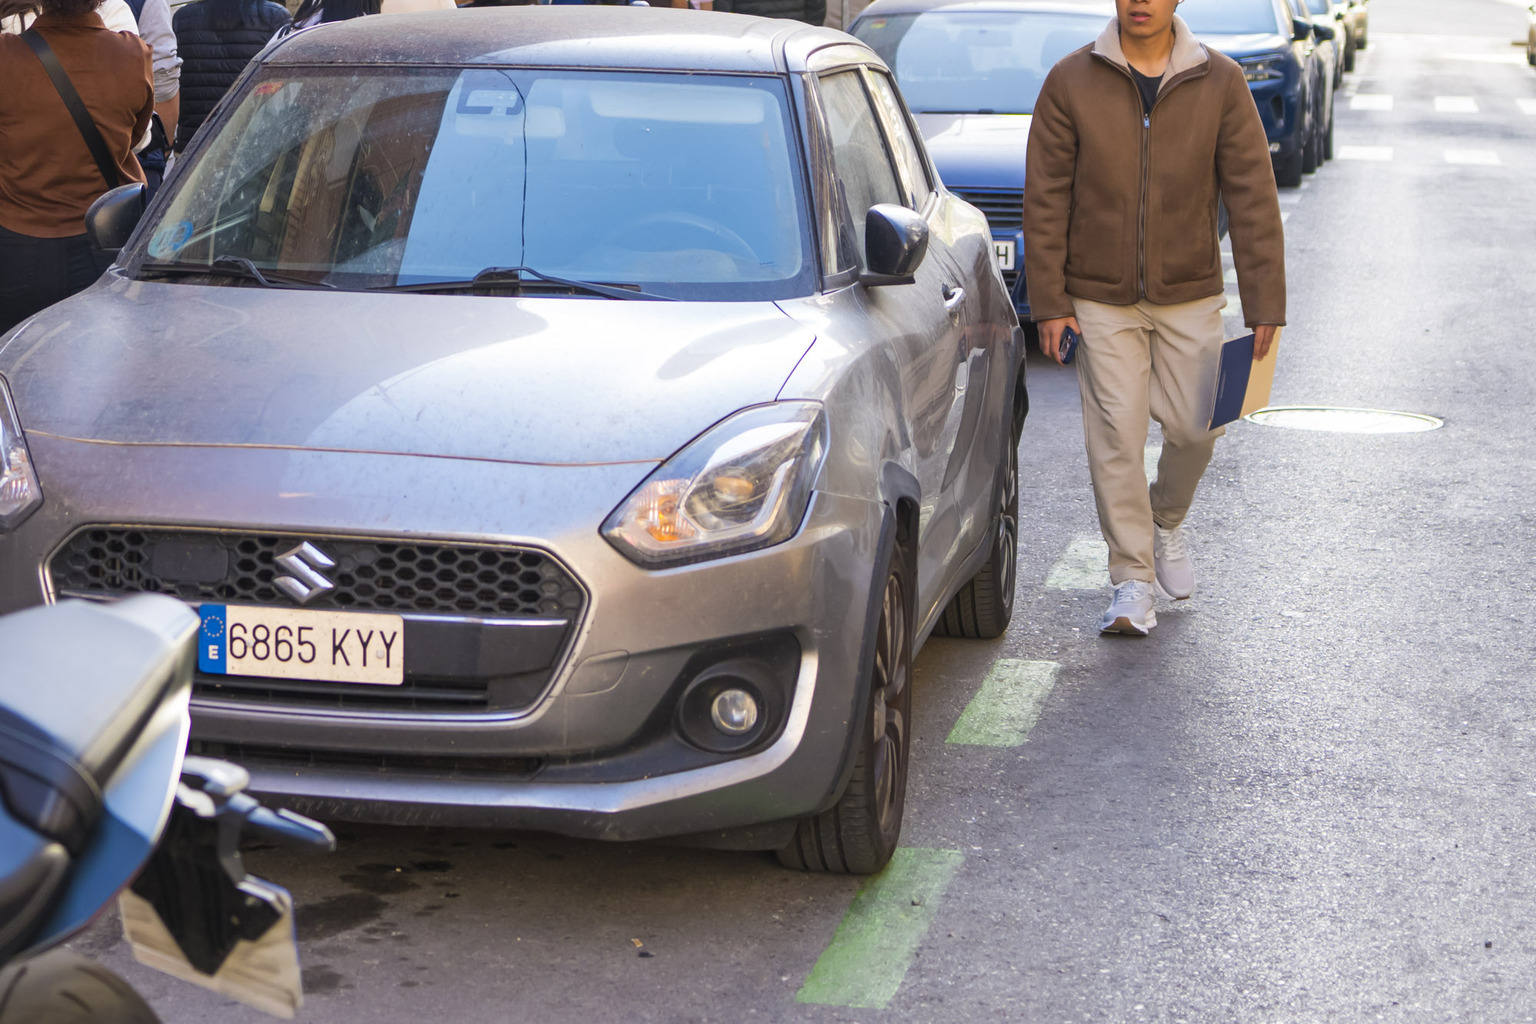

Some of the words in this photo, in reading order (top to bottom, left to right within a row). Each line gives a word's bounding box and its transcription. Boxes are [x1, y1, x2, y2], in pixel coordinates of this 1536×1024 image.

[208, 645, 219, 660] E
[229, 622, 317, 664] 6865
[331, 628, 398, 669] KYY
